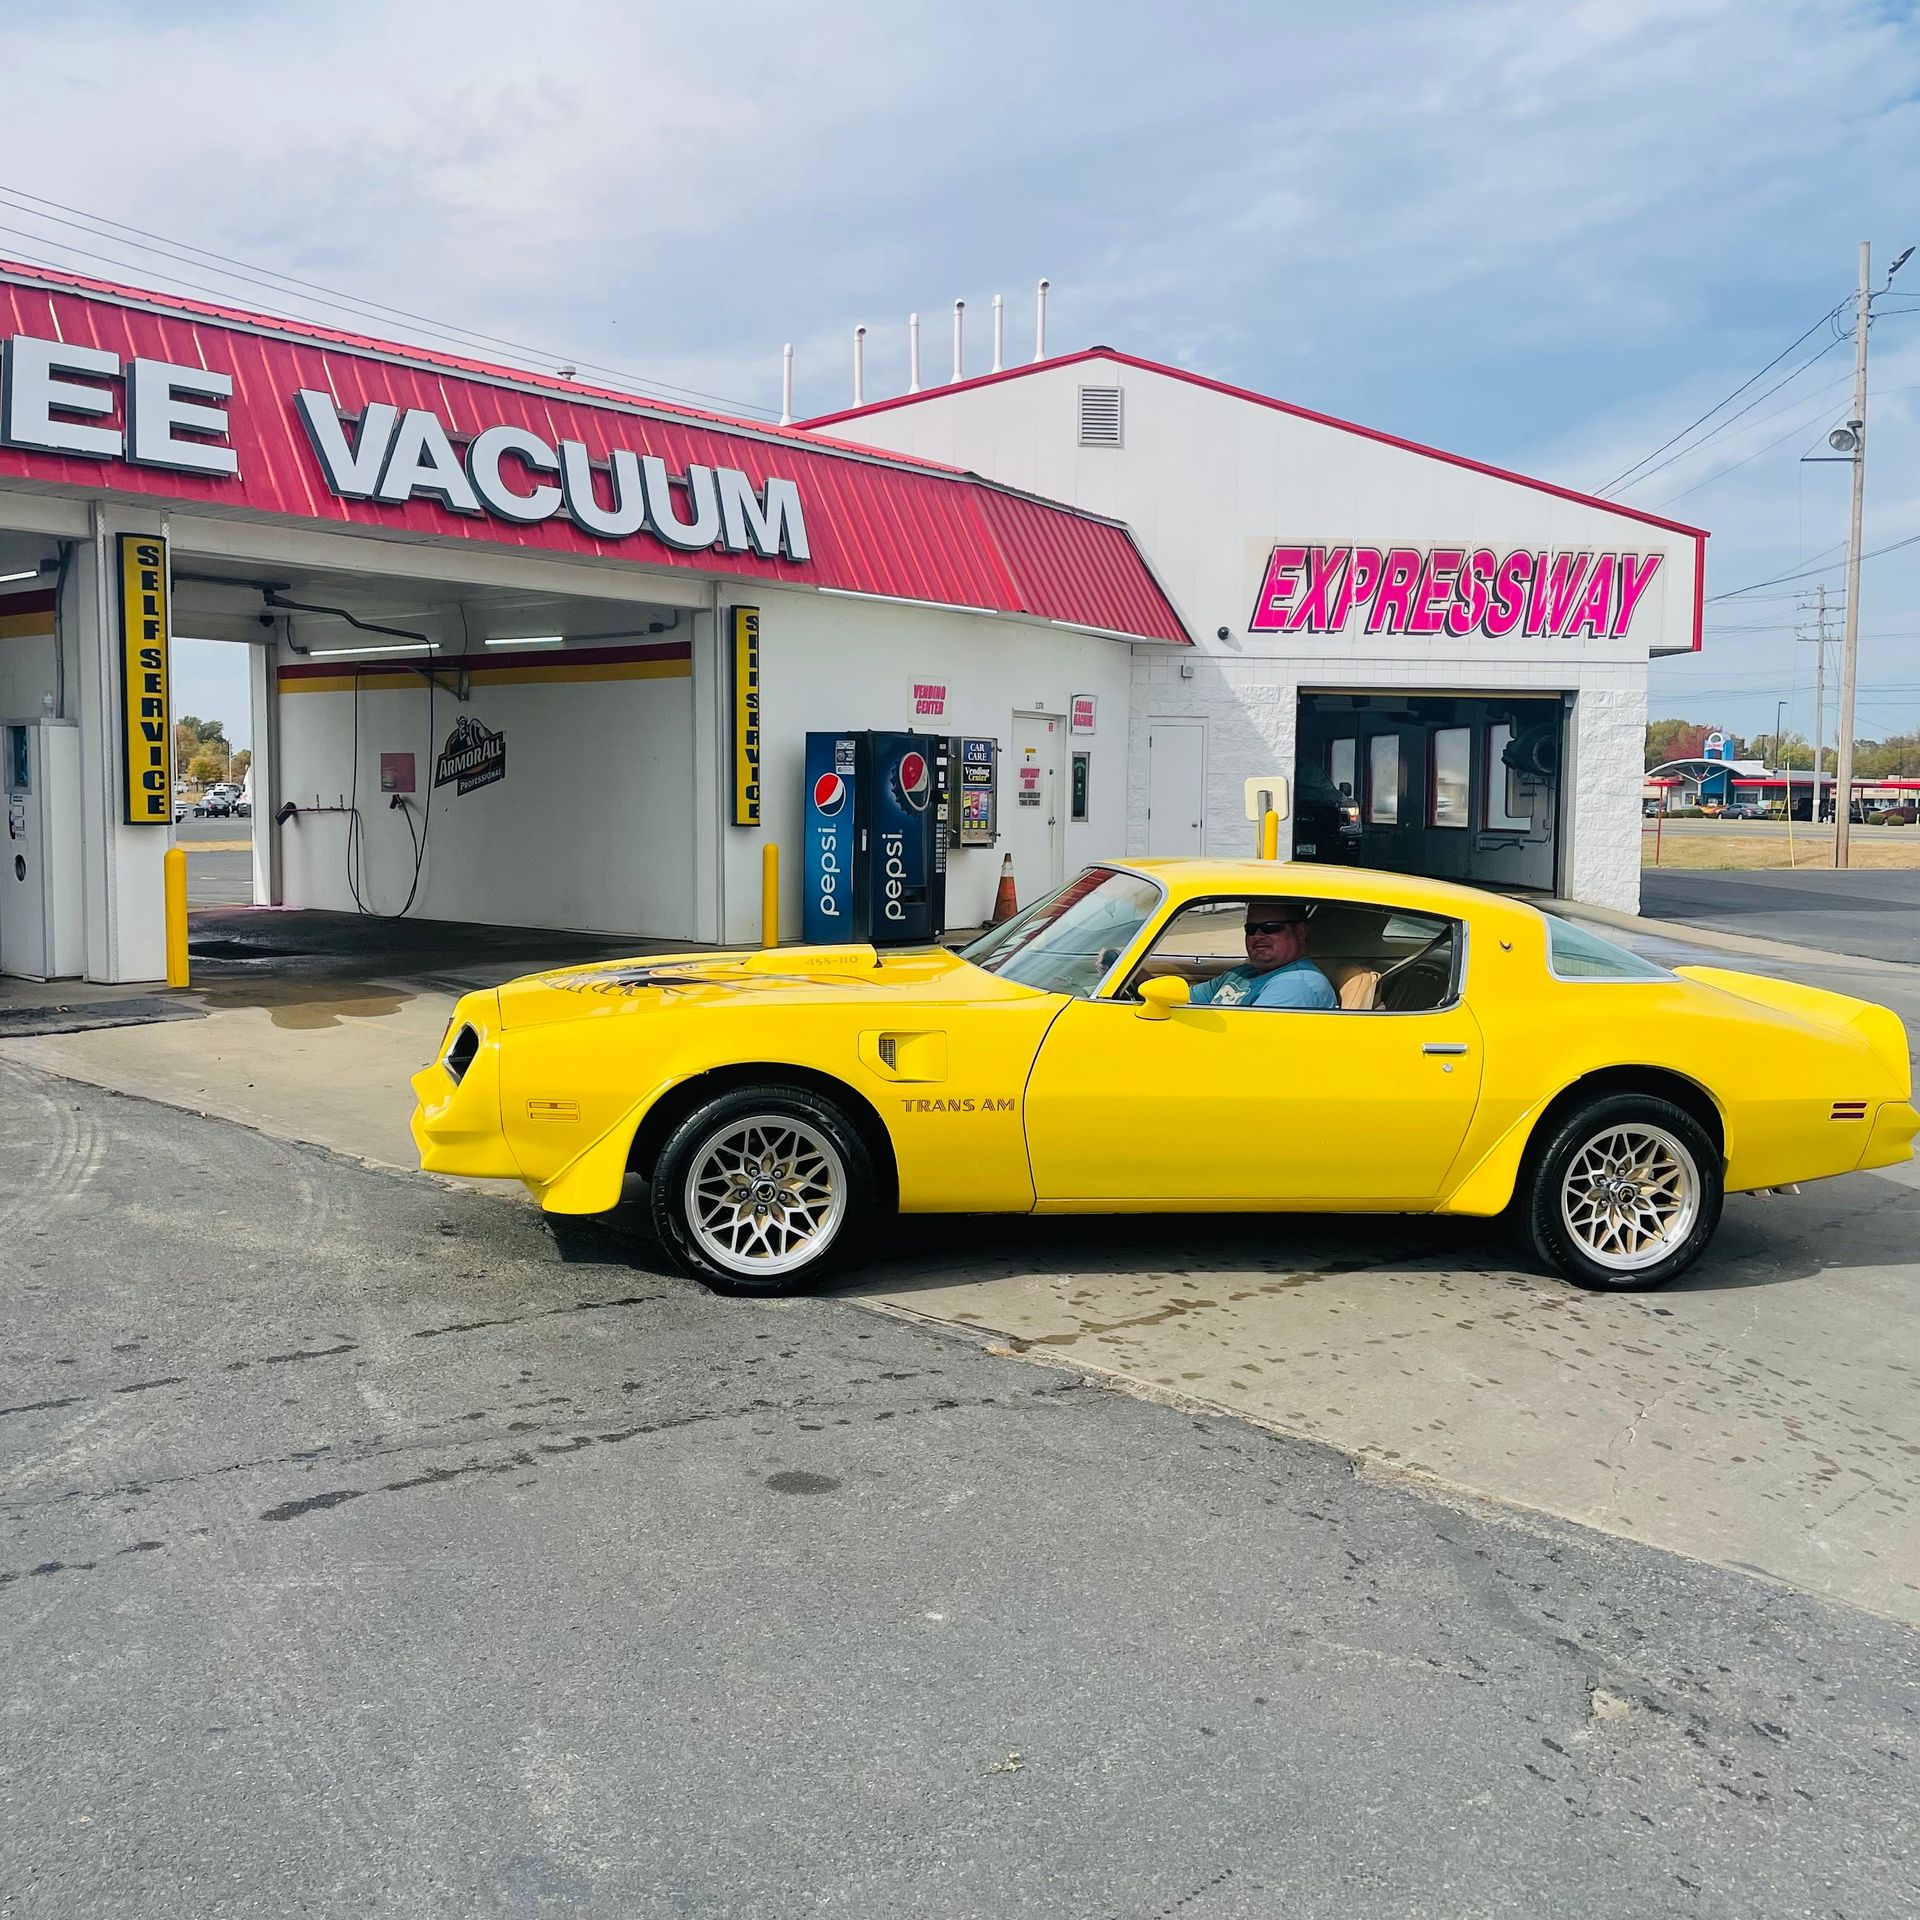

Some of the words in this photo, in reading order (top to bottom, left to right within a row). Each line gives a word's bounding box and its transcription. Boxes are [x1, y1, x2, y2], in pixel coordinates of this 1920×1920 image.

[295, 387, 811, 562] VACUUM
[137, 546, 161, 640] SELF
[1248, 545, 1664, 640] EXPRESSWAY
[914, 685, 946, 700] VENDING
[916, 700, 944, 715] CENTER
[140, 648, 165, 815] SERVICE
[968, 752, 987, 761] CARE
[970, 743, 985, 752] CAR
[964, 766, 990, 777] Vending
[817, 827, 840, 917] pepsi
[882, 833, 906, 920] pepsi
[901, 1098, 975, 1113] TRANS
[981, 1098, 1015, 1112] AM
